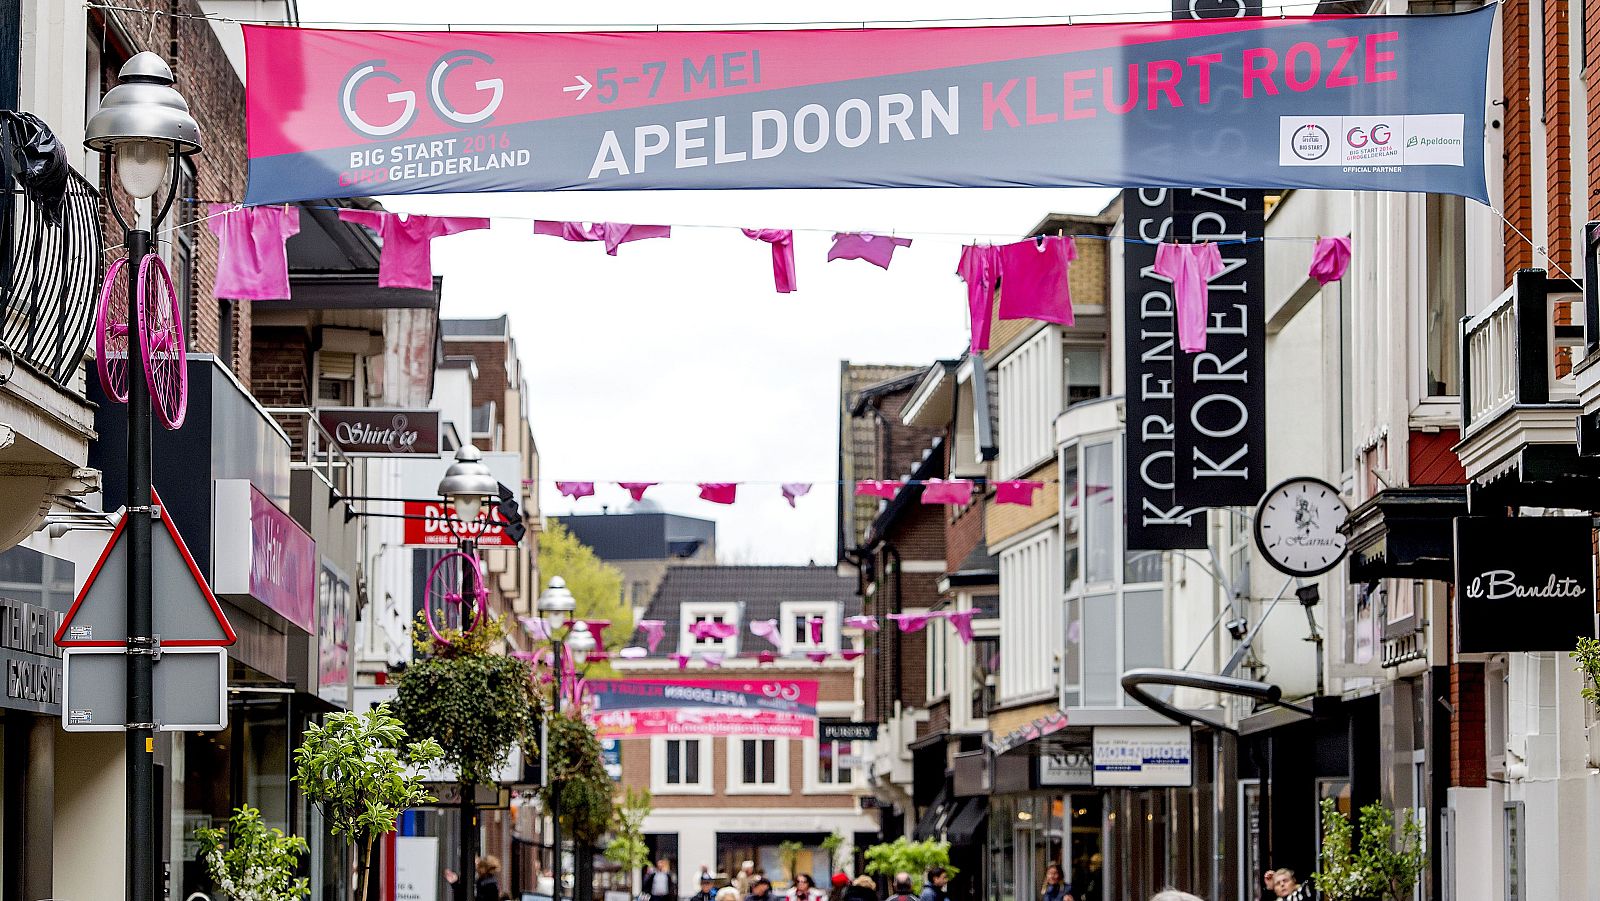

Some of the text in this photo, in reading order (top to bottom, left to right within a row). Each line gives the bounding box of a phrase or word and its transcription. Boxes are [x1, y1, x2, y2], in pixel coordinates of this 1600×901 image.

[596, 48, 762, 104] 5-7 MEI
[587, 31, 1399, 179] APELDOORN KLEURT ROZE
[350, 131, 511, 169] BIG START 2016
[1360, 147, 1378, 155] START
[1420, 136, 1461, 146] Apeldoorn
[338, 149, 530, 187] GIROGELDERLAND
[335, 421, 397, 445] Shirts
[1466, 569, 1587, 600] il Bandito
